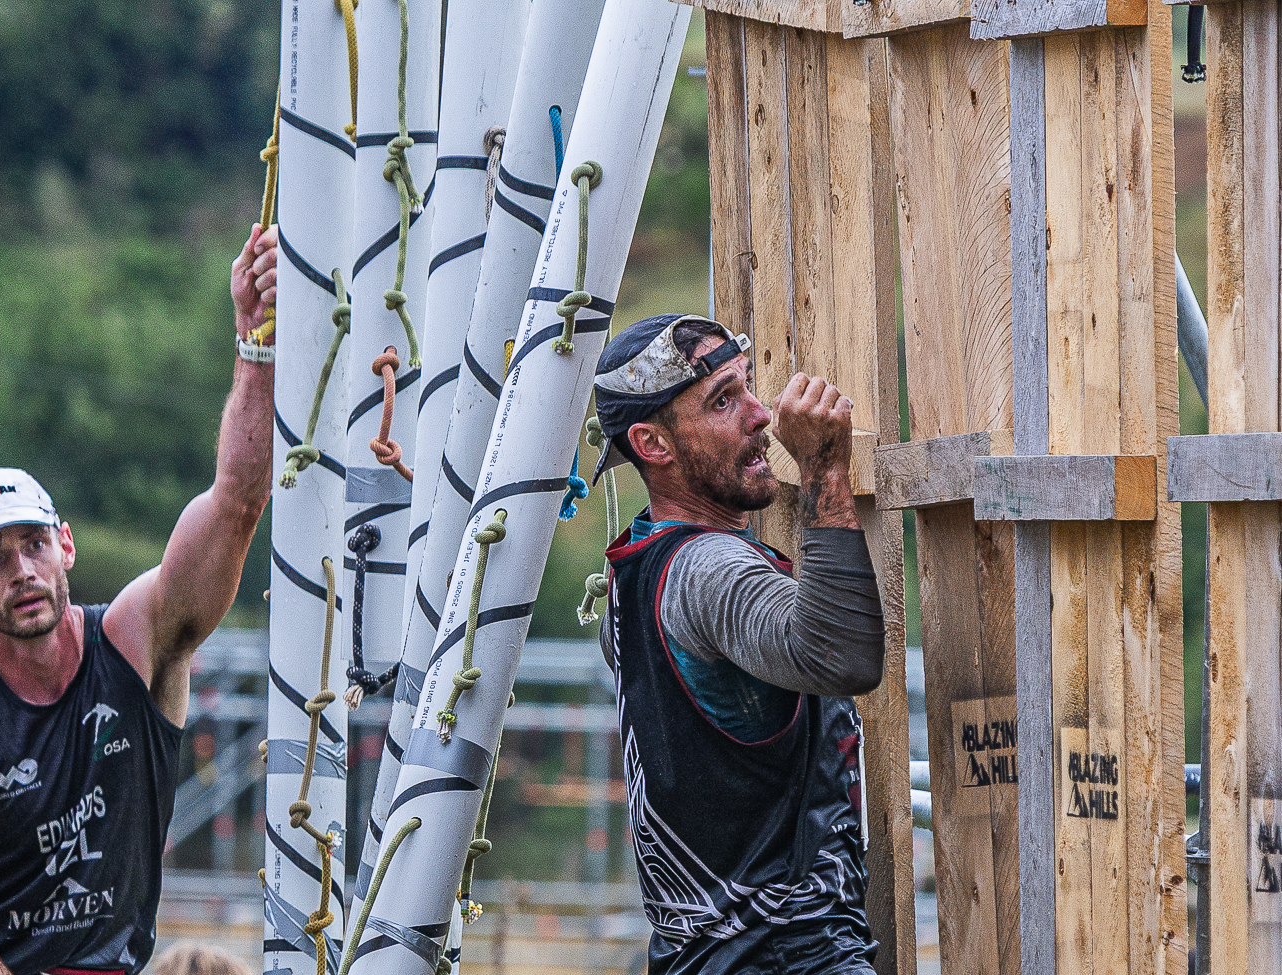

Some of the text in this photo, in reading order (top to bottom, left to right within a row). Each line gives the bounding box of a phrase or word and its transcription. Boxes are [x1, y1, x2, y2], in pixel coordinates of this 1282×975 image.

[290, 51, 298, 94] RECYCLABLE
[538, 266, 548, 288] ULLY
[544, 218, 561, 262] RECYCLABLE
[962, 720, 1018, 753] BLAZIN
[991, 755, 1018, 785] HILL
[1068, 751, 1119, 786] BLAZING
[1089, 789, 1119, 820] HILLS
[7, 886, 115, 931] MORVEN
